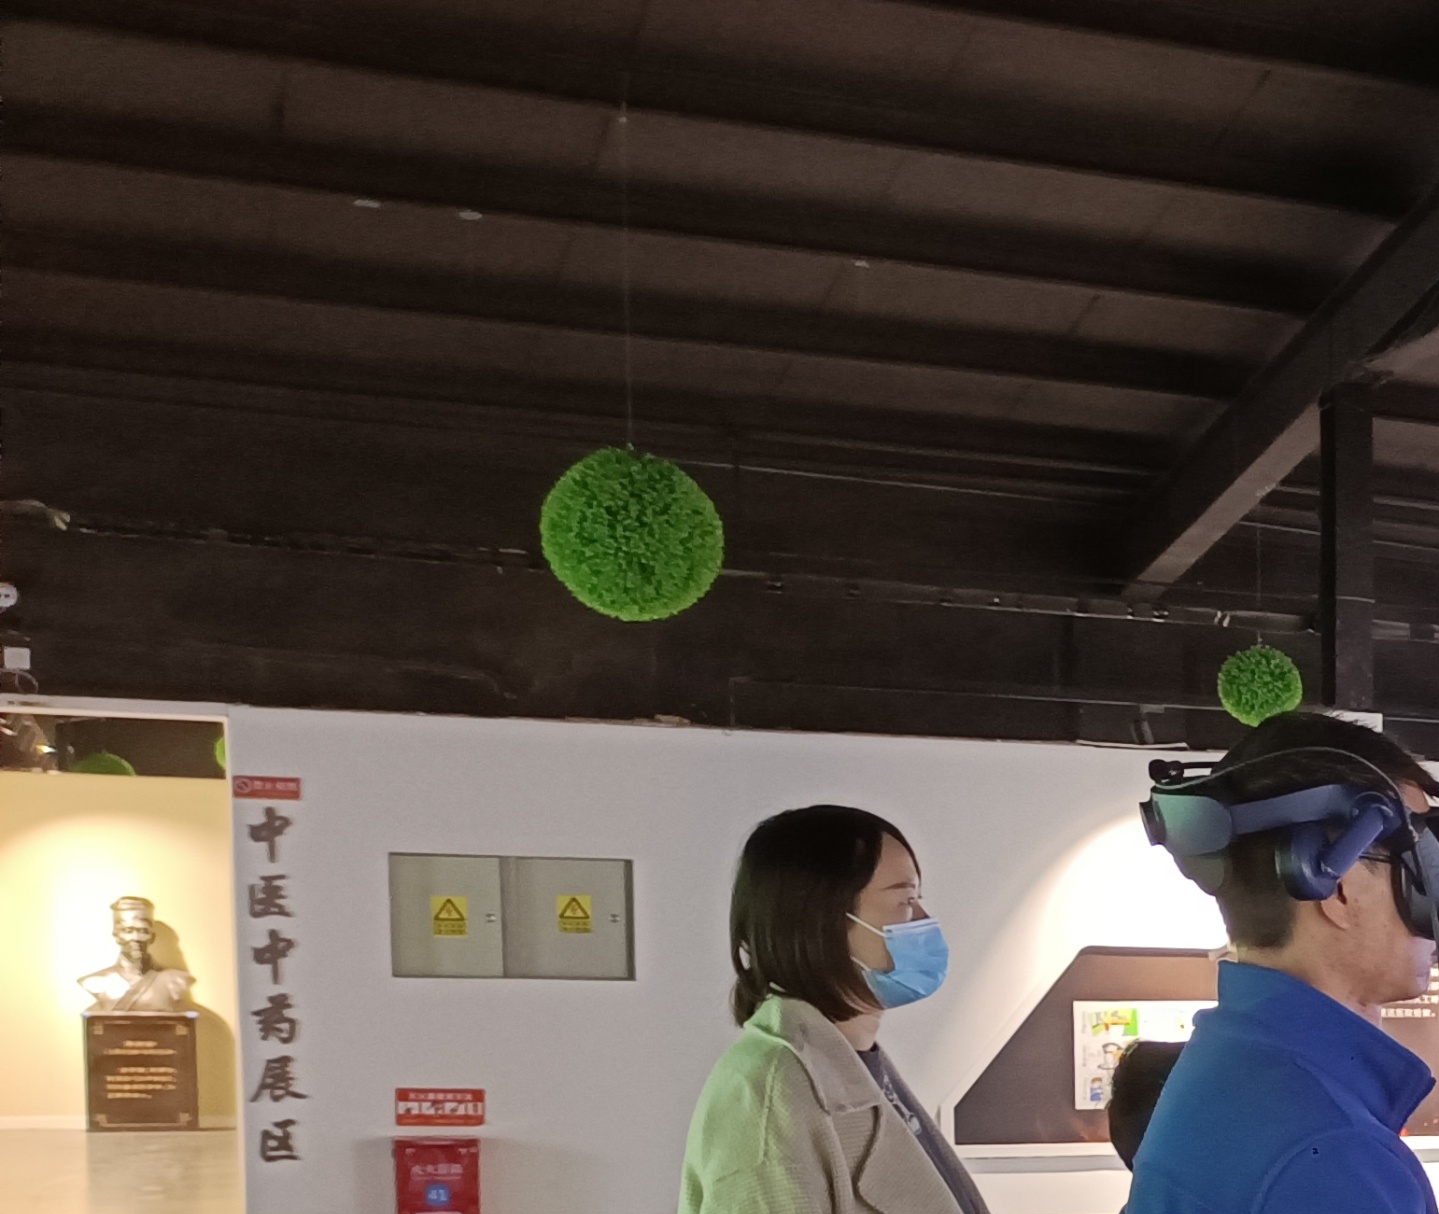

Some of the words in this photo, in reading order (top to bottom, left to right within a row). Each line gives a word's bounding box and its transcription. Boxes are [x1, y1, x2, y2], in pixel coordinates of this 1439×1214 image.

[246, 805, 308, 1163] 中医中药展区
